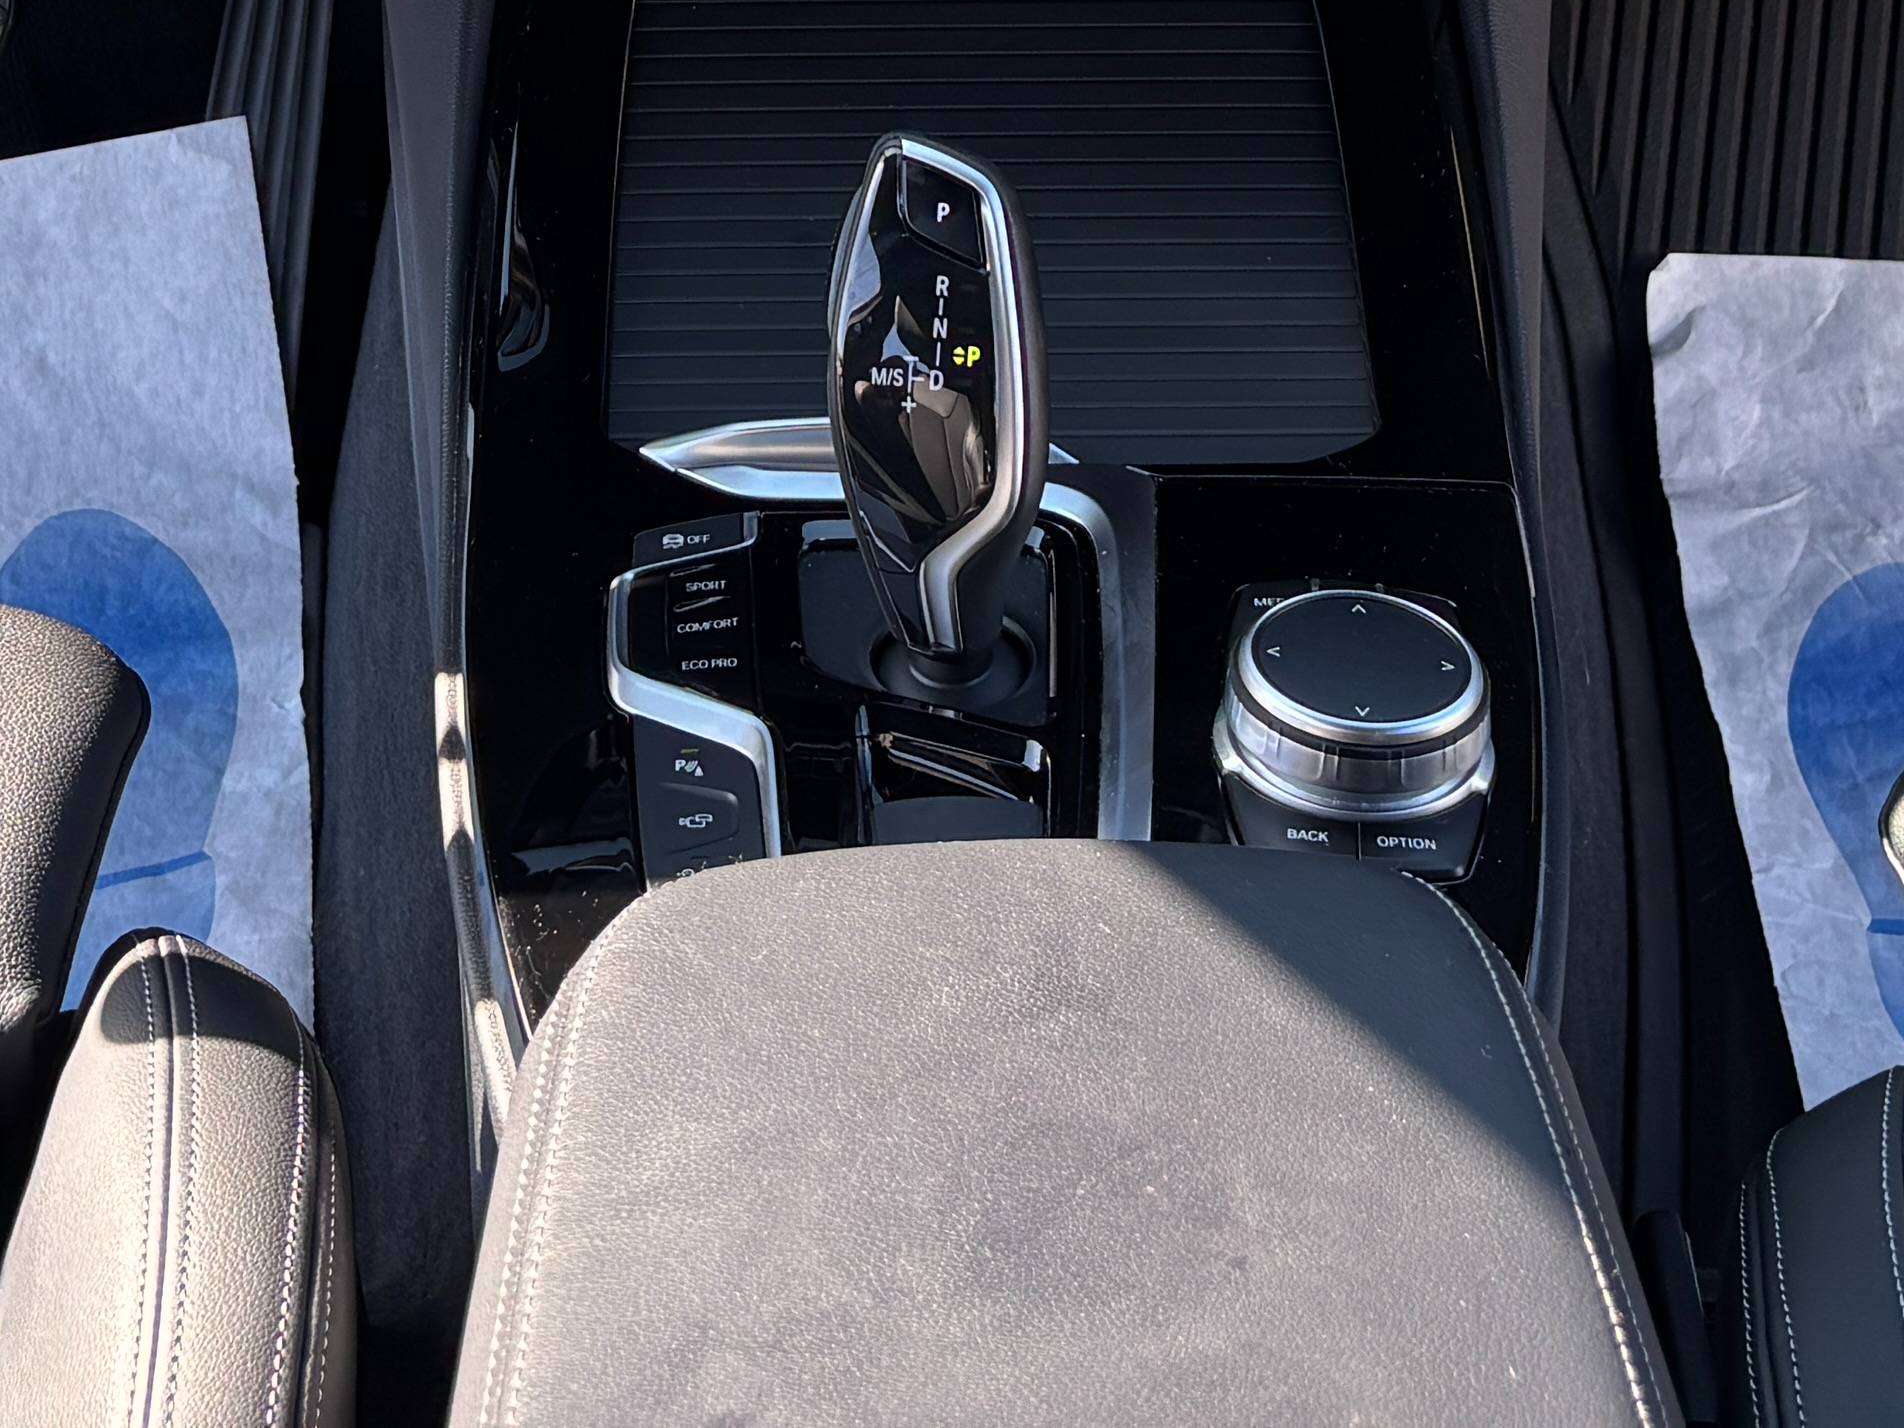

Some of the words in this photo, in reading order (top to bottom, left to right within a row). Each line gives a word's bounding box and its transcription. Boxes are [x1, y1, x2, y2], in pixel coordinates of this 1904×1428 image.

[935, 202, 951, 223] P
[934, 274, 950, 298] R
[931, 316, 948, 340] N
[966, 345, 982, 368] P
[870, 367, 905, 387] M/S
[928, 369, 945, 391] D
[686, 533, 711, 545] OFF
[685, 580, 727, 593] SPORT
[677, 616, 739, 634] COMFORT
[681, 659, 709, 671] ECO
[711, 657, 738, 669] PRO
[1286, 827, 1330, 844] BACK
[1376, 835, 1437, 852] OPTION
